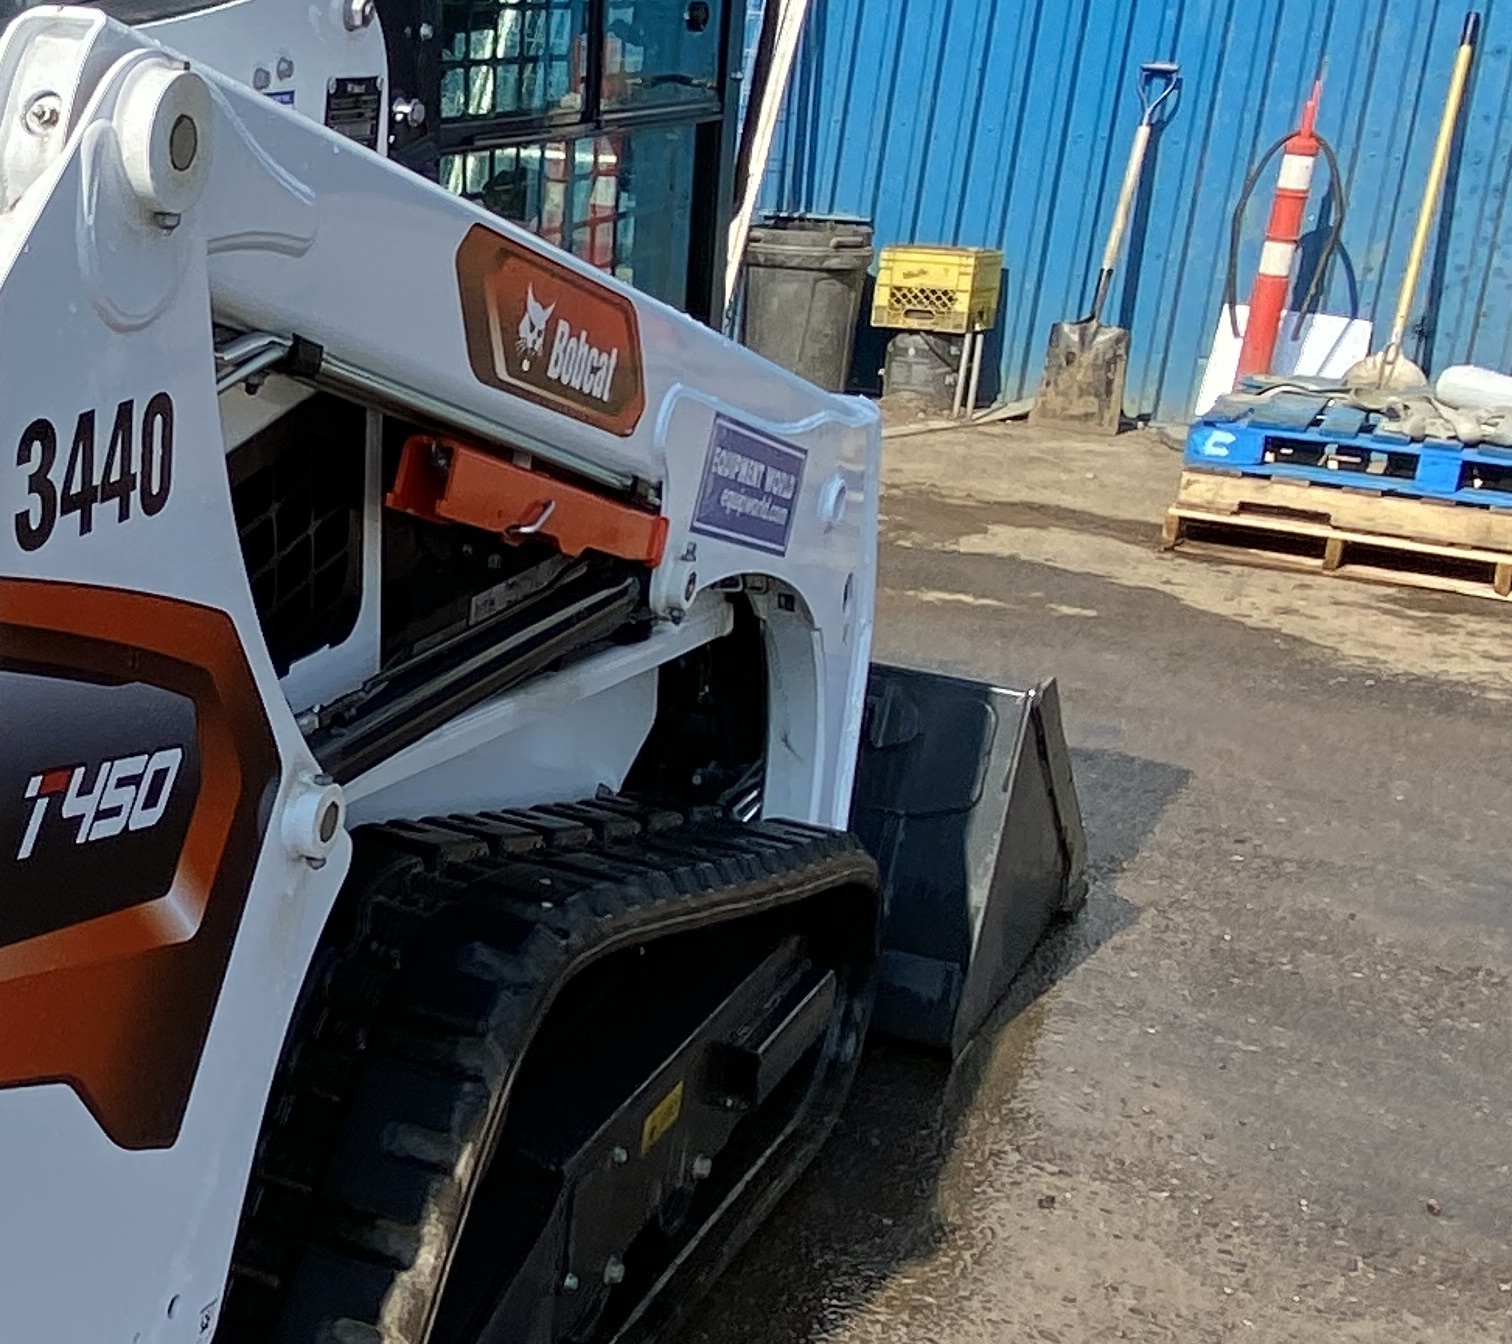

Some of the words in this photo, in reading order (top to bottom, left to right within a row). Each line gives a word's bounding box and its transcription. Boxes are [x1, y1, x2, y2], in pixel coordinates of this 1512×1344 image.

[547, 318, 618, 402] Bobcat
[15, 391, 174, 552] 3440
[16, 747, 183, 861] T450
